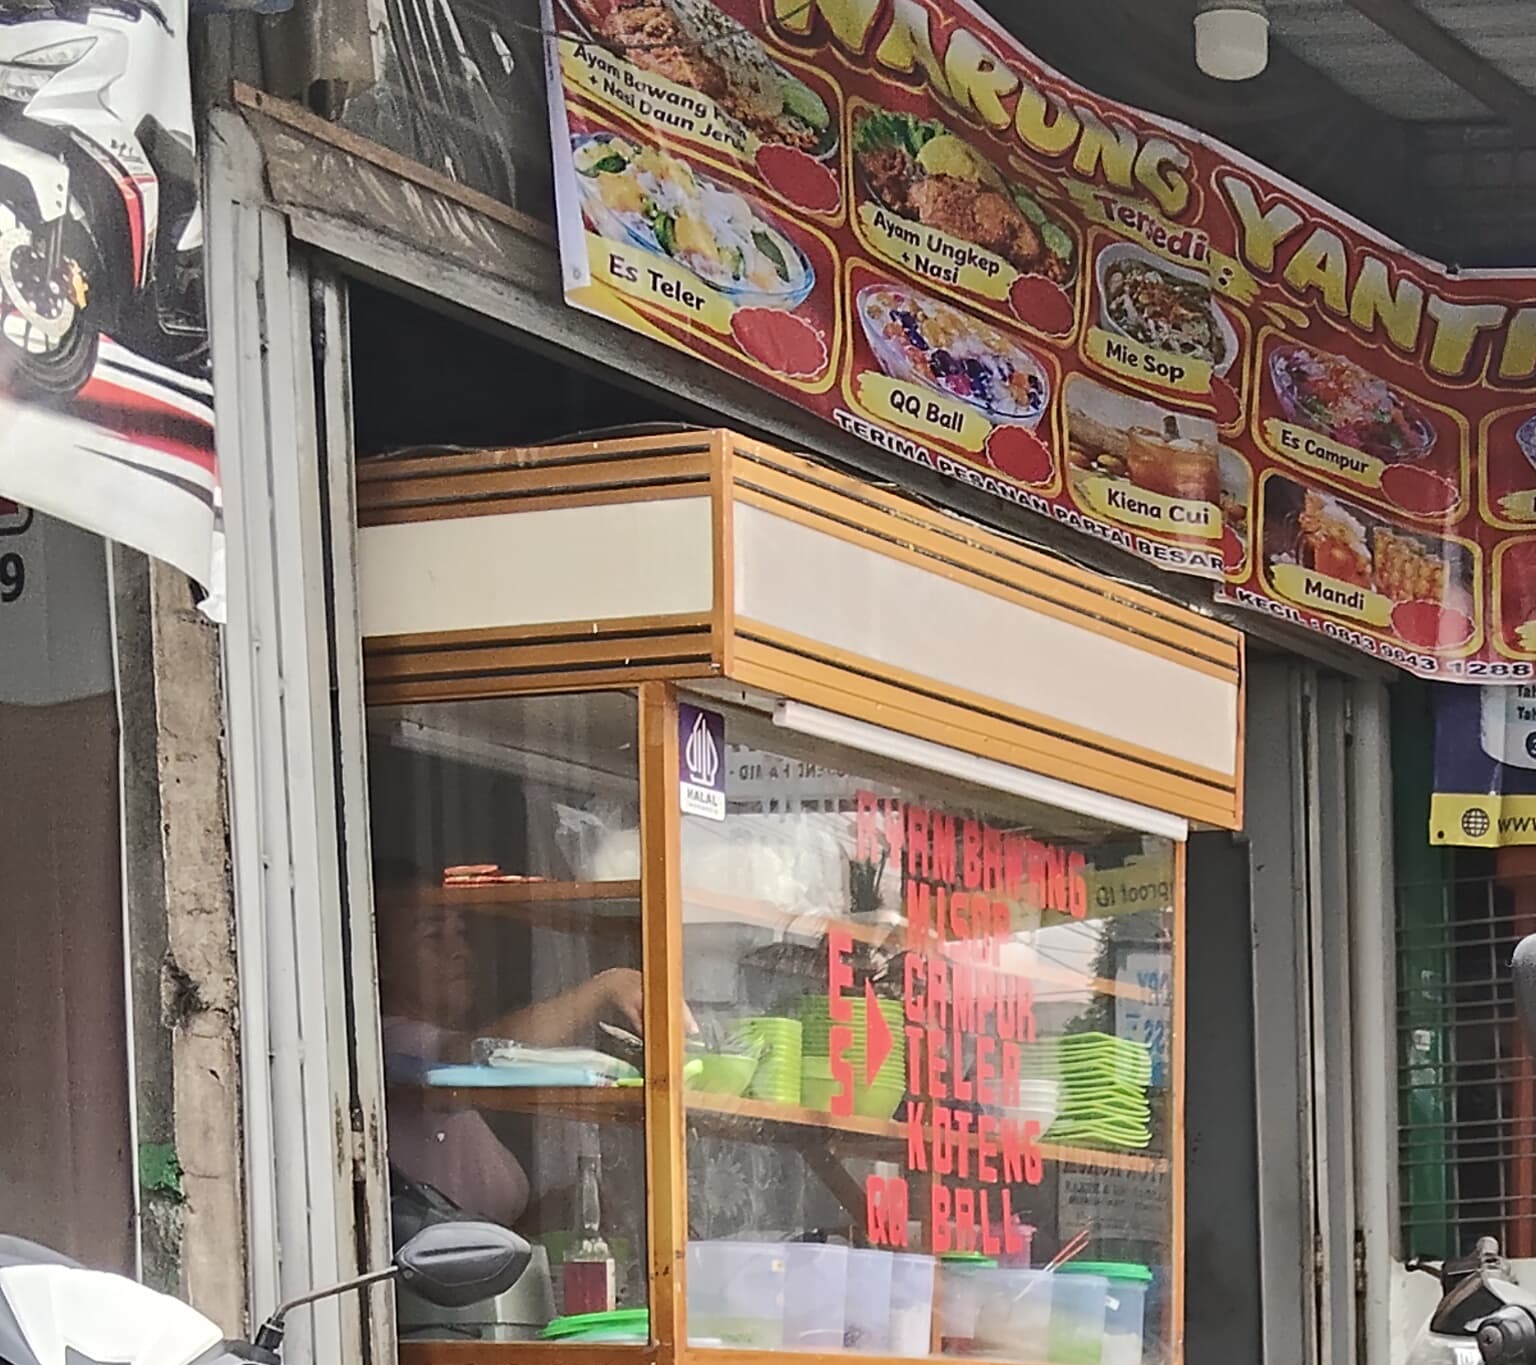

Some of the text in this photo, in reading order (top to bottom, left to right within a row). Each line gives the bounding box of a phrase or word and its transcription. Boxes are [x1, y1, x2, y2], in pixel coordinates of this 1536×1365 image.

[573, 44, 620, 79] Ayam
[624, 71, 707, 118] Bawang
[603, 77, 635, 109] Nasi
[639, 99, 695, 132] Daun
[873, 210, 1000, 277] Ayam Ungkep
[1102, 195, 1210, 264] Tersedi
[609, 254, 705, 311] Es Teler
[914, 254, 959, 285] Nasi
[1106, 340, 1185, 382] Mie Sop
[889, 390, 964, 433] QQ Ball
[1281, 430, 1369, 475] Es Campur
[1107, 487, 1209, 525] Kiena Cui
[835, 411, 930, 466] TERIMA
[938, 458, 1048, 514] PESANAN
[1056, 505, 1131, 549] PARTAI
[1138, 540, 1224, 571] BESAR
[1236, 589, 1308, 627] KECIL
[1450, 662, 1531, 677] 1288
[1304, 578, 1365, 611] Mandi
[856, 790, 956, 884] AYAM
[904, 952, 1036, 1042] CAMPUR
[905, 1026, 1022, 1107] TELER
[907, 1101, 1043, 1185] KOTENG
[931, 1184, 1024, 1255] BALL
